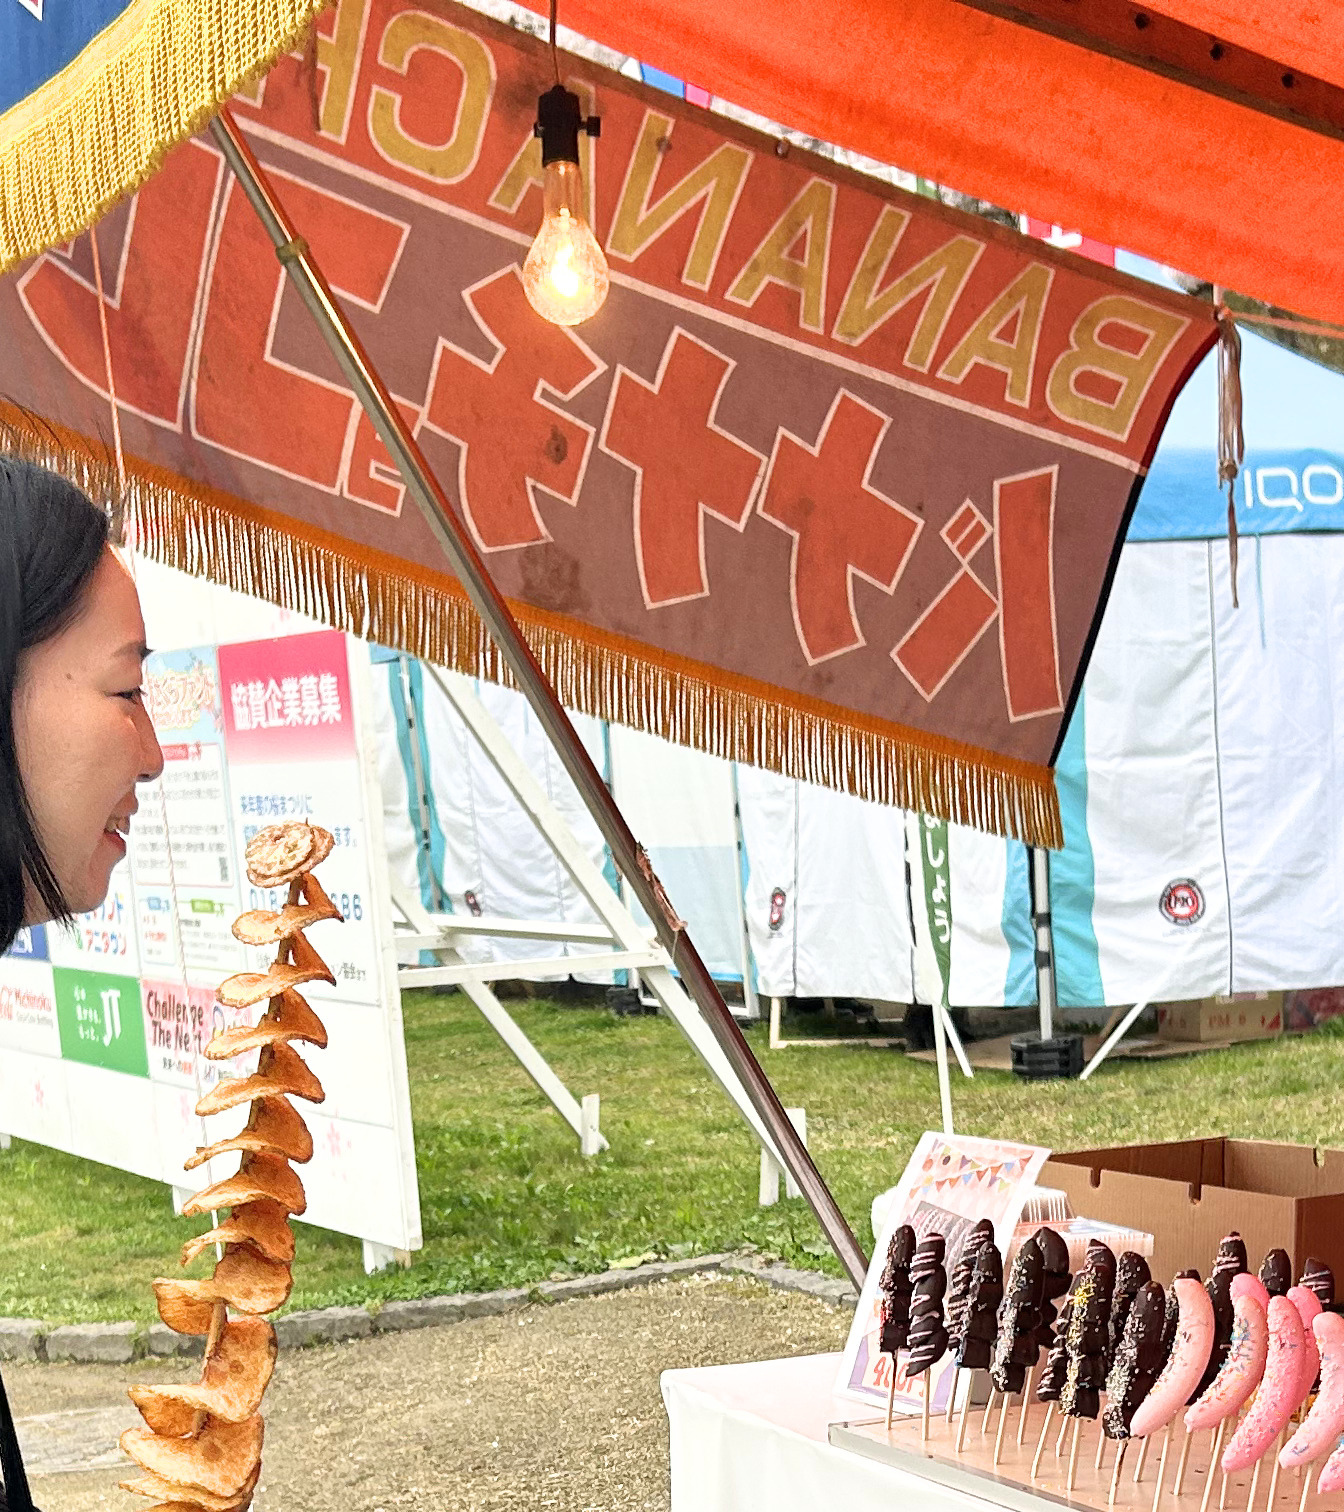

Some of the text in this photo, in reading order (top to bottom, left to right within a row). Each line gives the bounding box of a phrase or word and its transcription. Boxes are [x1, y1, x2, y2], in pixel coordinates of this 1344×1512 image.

[231, 672, 342, 731] 協賛企業募集
[100, 988, 122, 1046] JT
[152, 1019, 172, 1050] The
